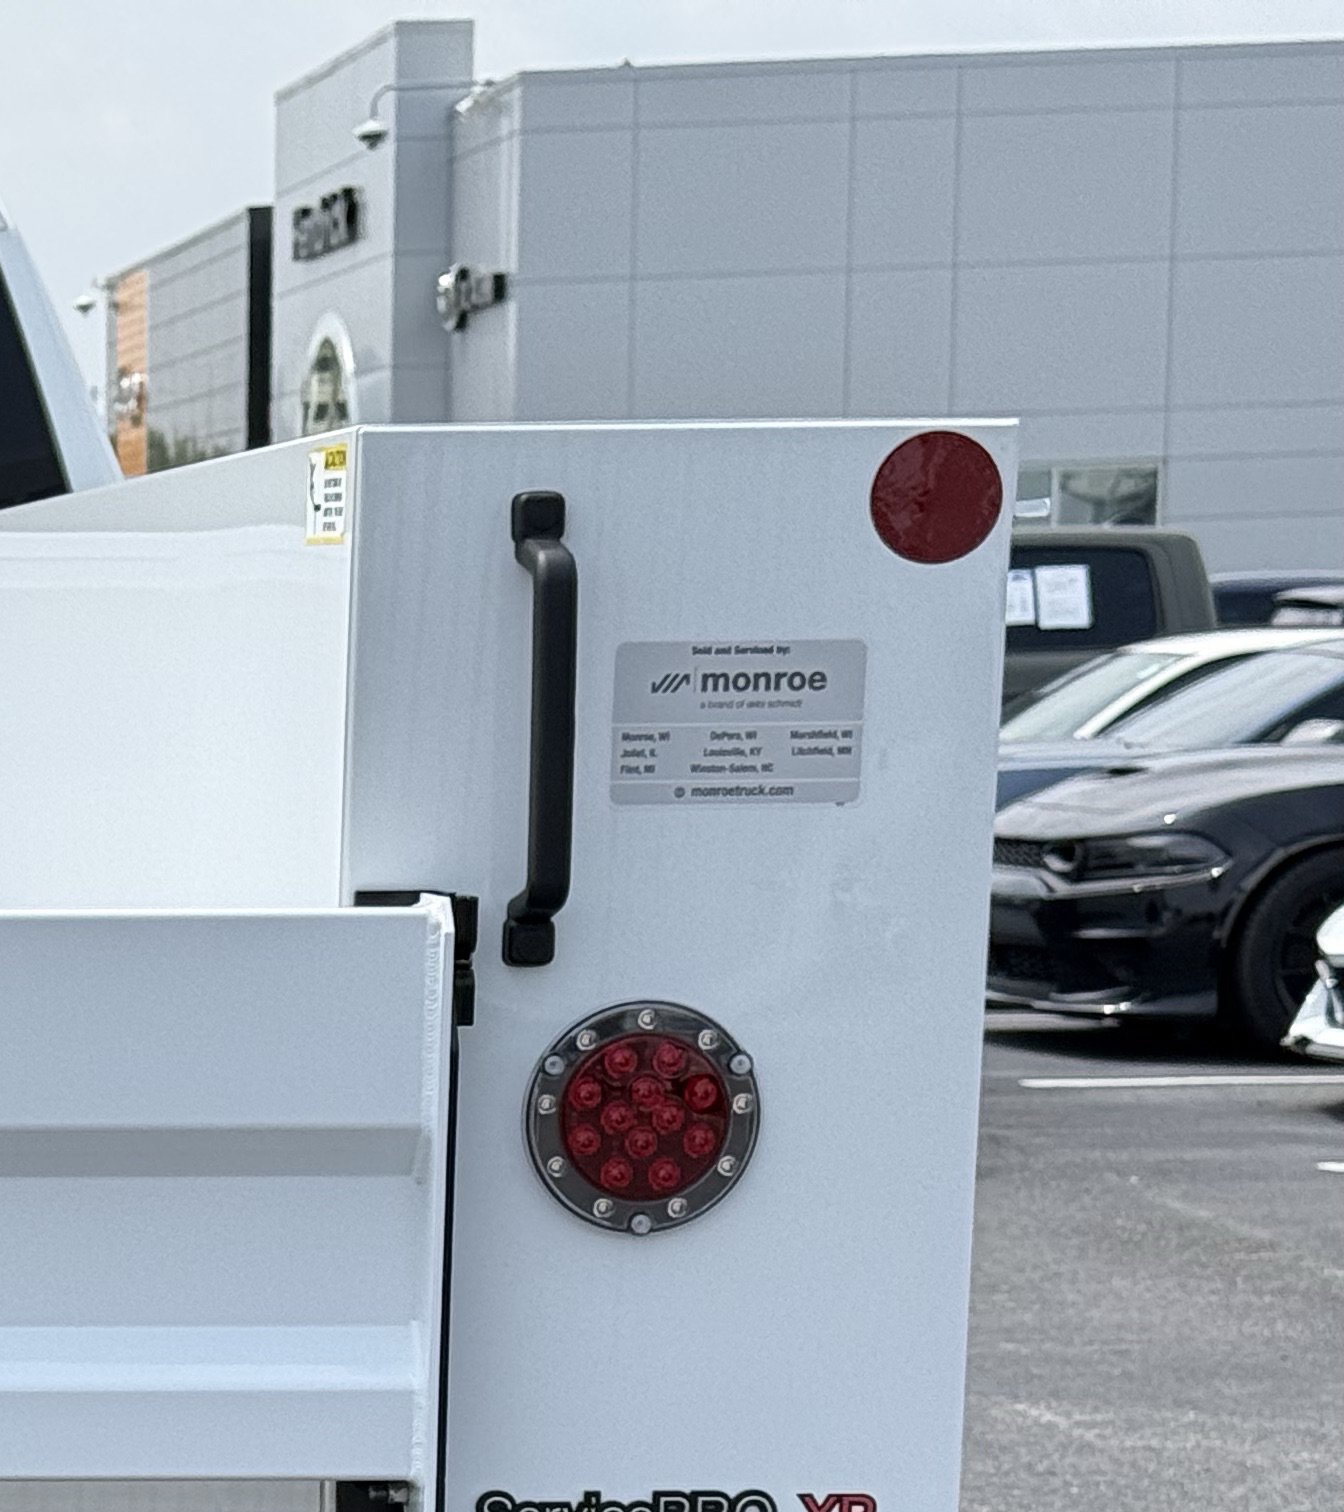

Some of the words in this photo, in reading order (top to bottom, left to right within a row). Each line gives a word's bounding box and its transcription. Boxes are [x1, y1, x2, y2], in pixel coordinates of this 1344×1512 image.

[714, 646, 731, 655] and
[700, 671, 828, 693] monroe
[622, 732, 656, 743] Monroe,
[691, 785, 794, 797] monroetruck.com
